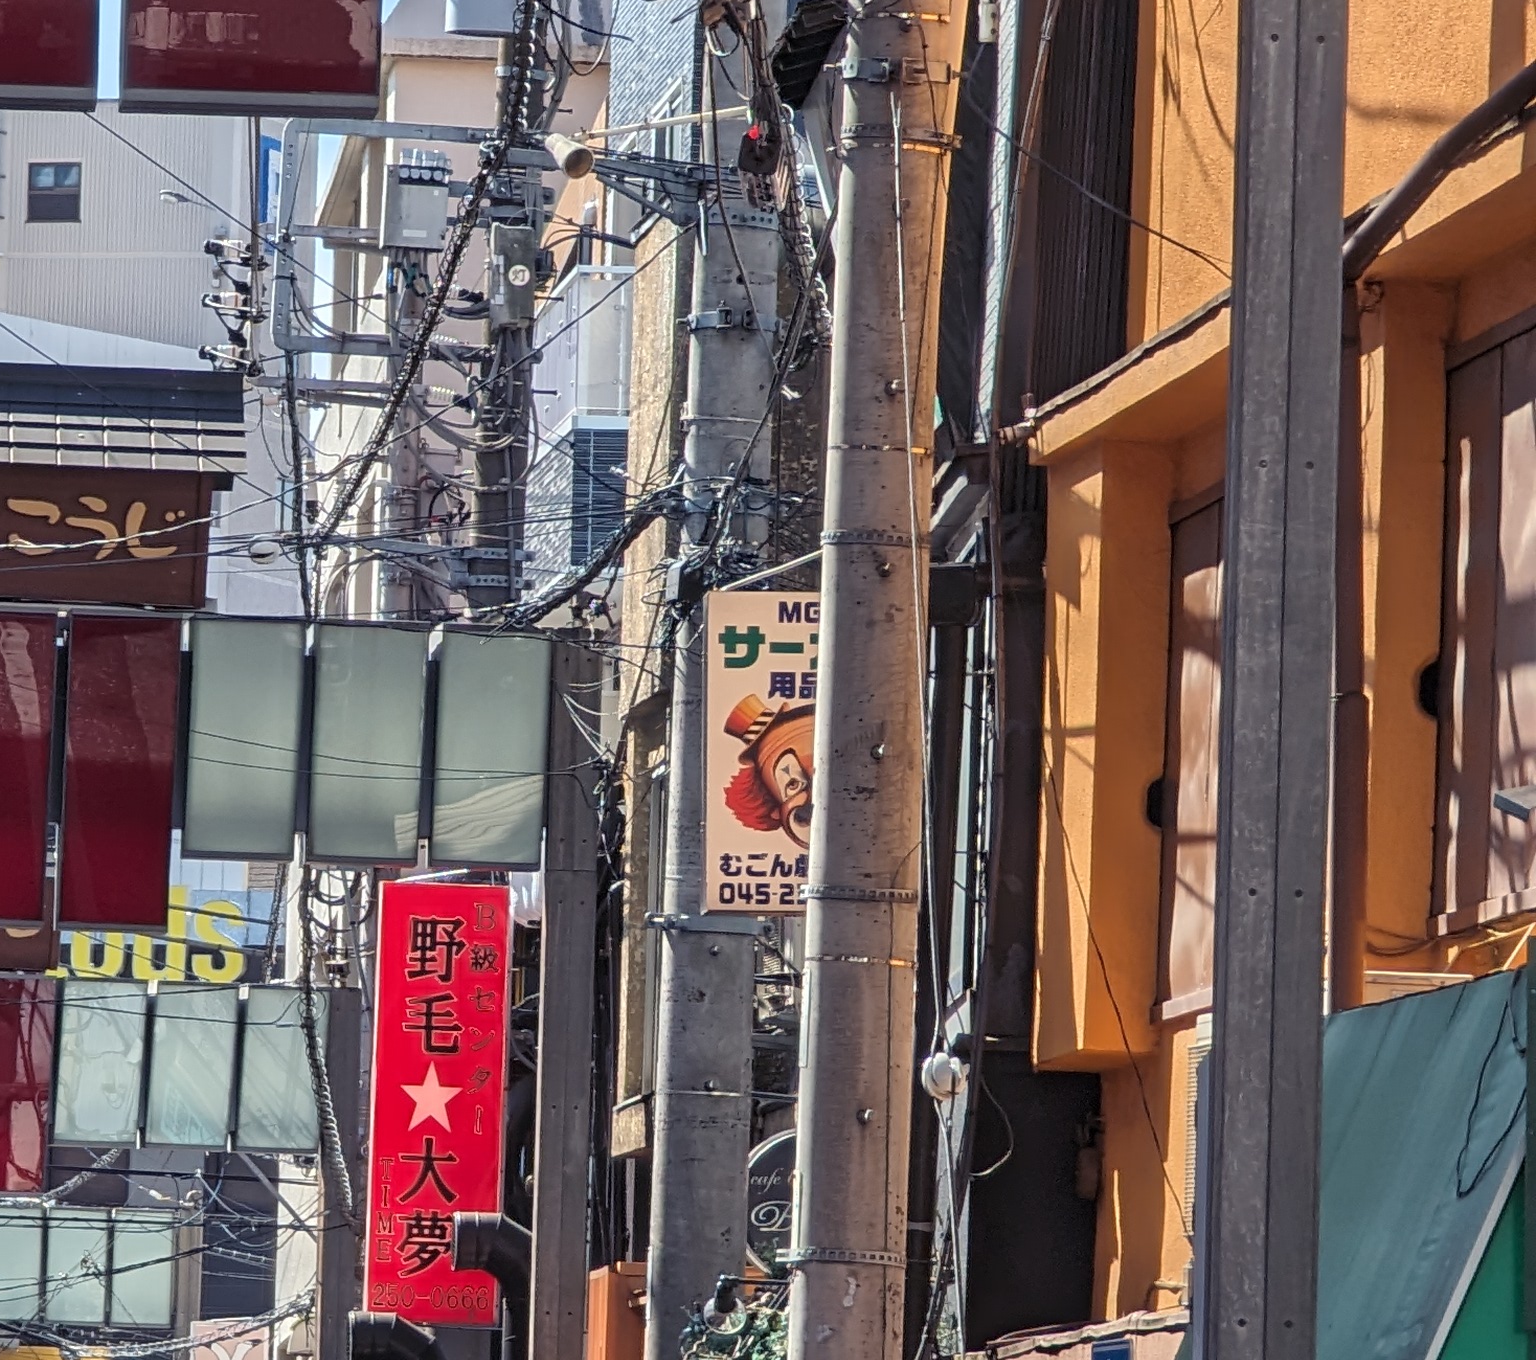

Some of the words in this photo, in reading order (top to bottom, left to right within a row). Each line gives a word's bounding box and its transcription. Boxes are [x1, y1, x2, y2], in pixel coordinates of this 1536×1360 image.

[465, 902, 498, 1135] B級センター
[376, 1157, 395, 1262] TIME
[750, 1167, 784, 1195] cafe
[371, 1282, 489, 1311] 250-0666
